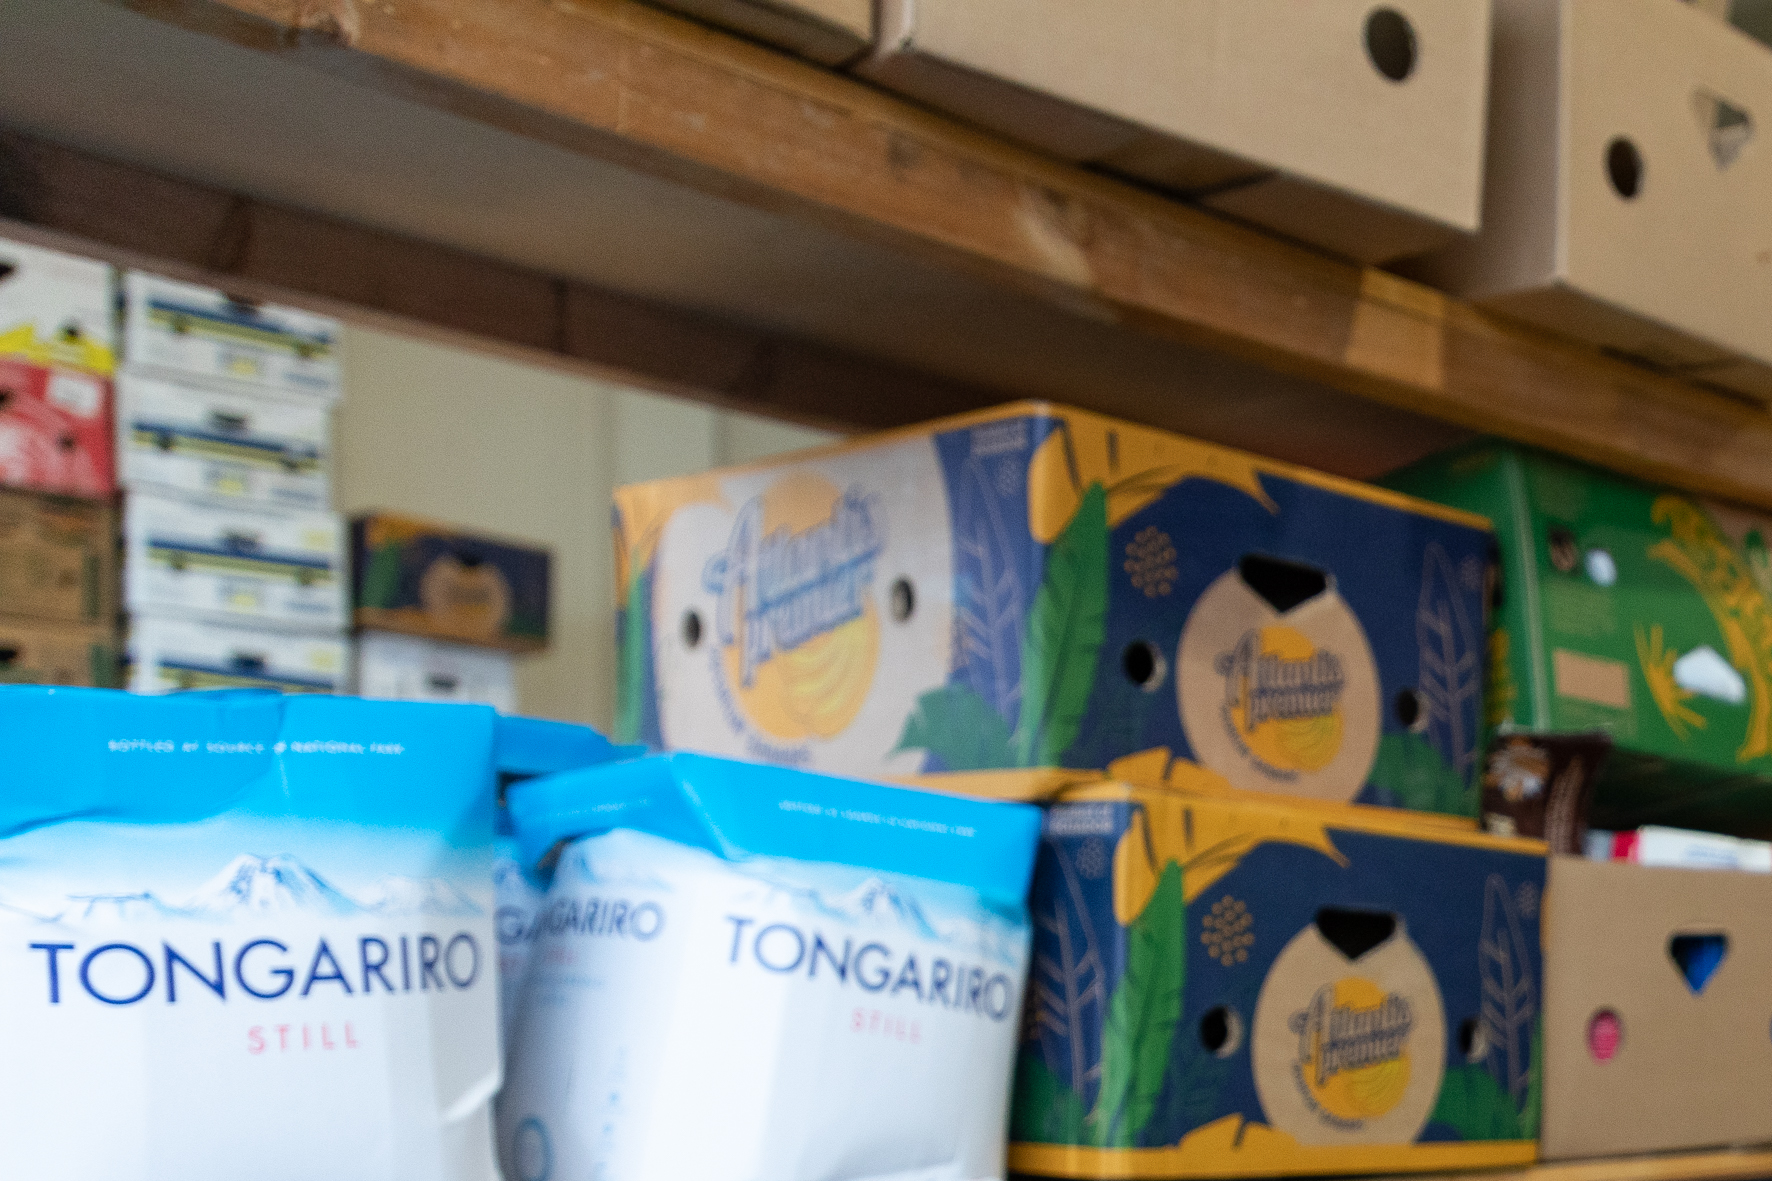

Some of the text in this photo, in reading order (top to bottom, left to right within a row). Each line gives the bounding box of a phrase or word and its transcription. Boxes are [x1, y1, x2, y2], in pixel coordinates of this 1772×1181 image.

[29, 932, 483, 1006] TONGARIRO
[725, 914, 1017, 1022] TONGARIRO
[247, 1022, 361, 1055] STILL
[850, 1007, 923, 1045] STILL
